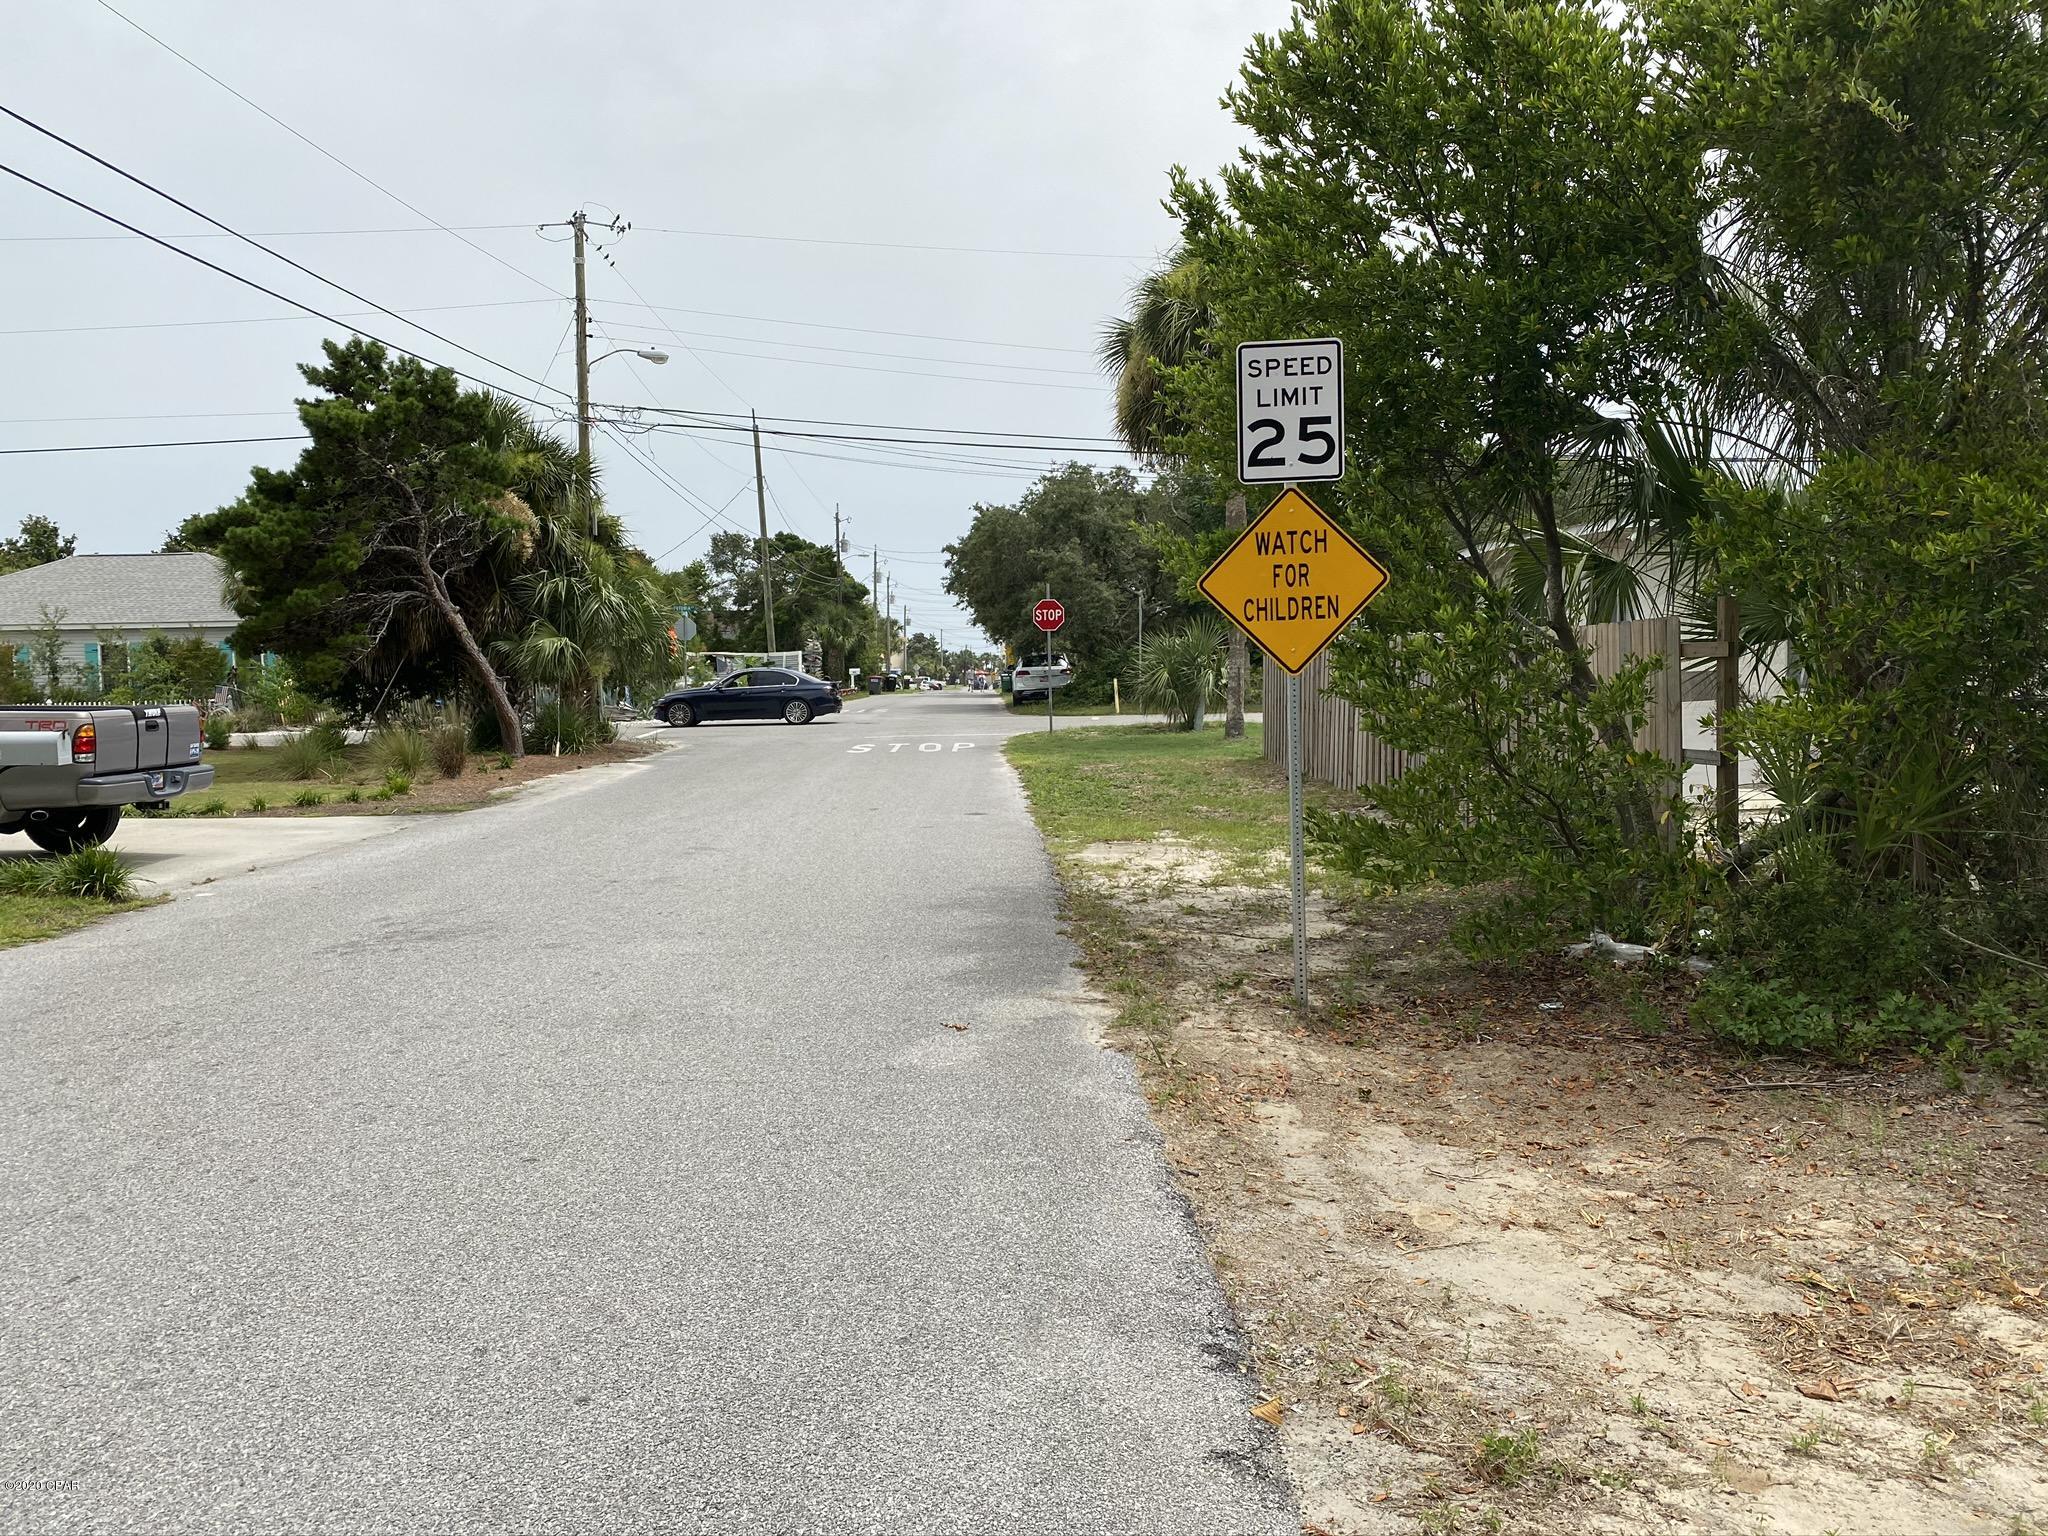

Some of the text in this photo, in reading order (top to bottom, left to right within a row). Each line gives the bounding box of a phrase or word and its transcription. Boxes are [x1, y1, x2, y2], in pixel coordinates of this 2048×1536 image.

[1247, 356, 1333, 378] SPEED
[1257, 386, 1324, 408] LIMIT
[1247, 416, 1336, 468] 25
[1255, 529, 1328, 556] WATCH
[1273, 563, 1310, 588] FOR
[1035, 609, 1062, 621] STOP
[1243, 595, 1340, 622] CHILDREN
[25, 720, 67, 731] TRD
[847, 742, 975, 753] STOP
